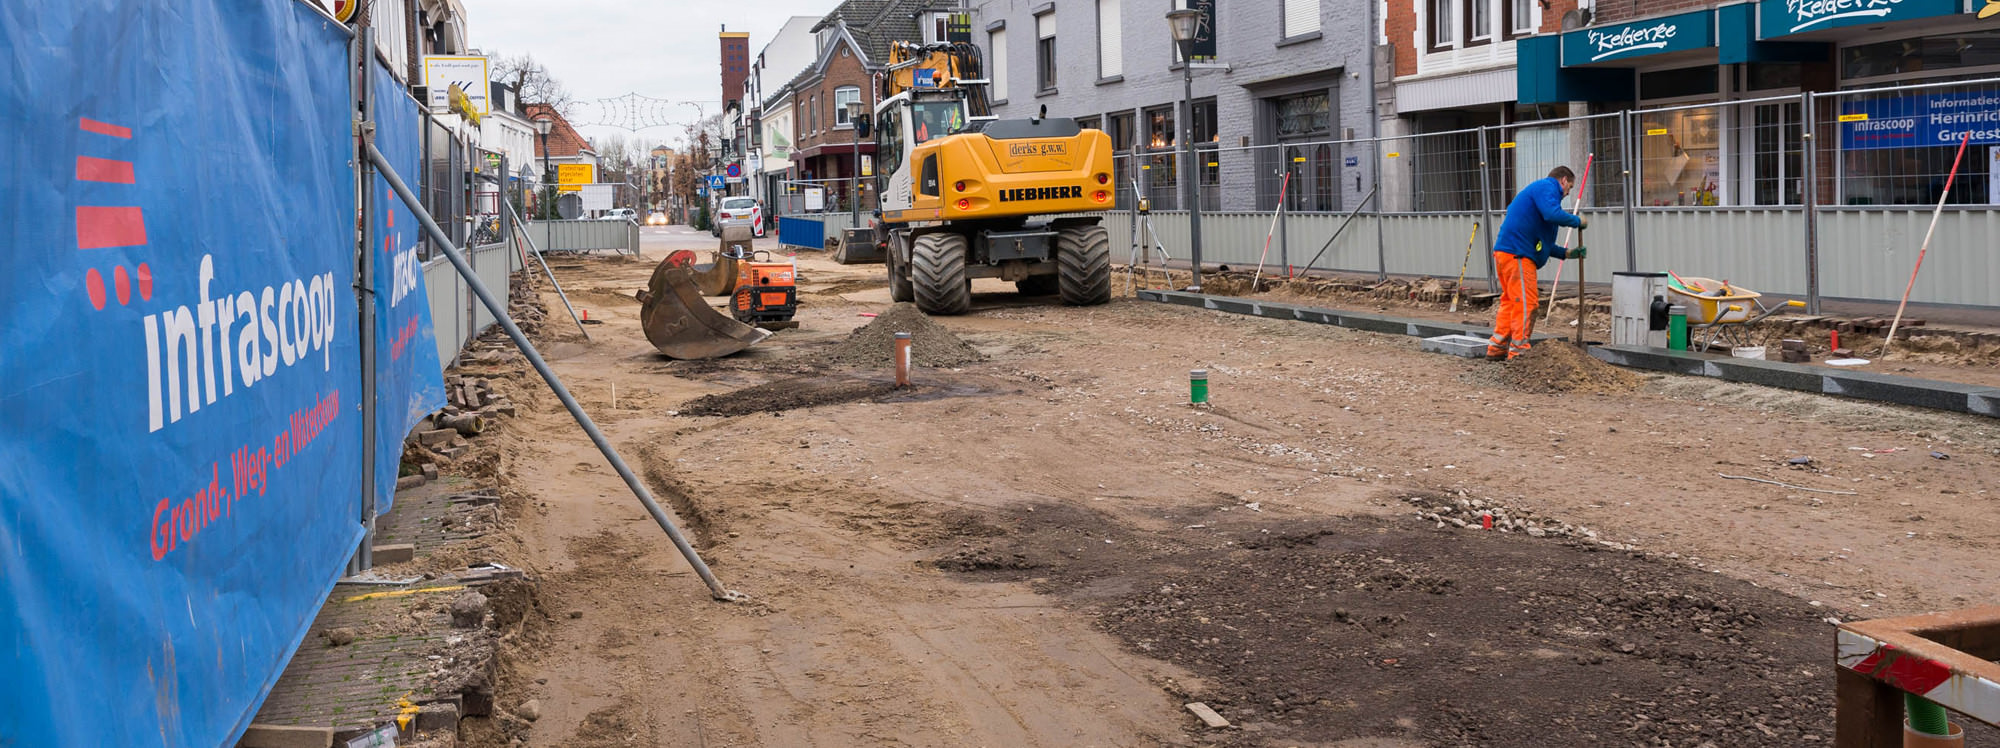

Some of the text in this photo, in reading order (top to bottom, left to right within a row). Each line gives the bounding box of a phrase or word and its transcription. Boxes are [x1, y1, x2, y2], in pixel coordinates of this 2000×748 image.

[1598, 23, 1676, 52] Kelderke
[1854, 118, 1914, 132] infrascoop
[1930, 110, 2000, 125] Herinric
[1011, 144, 1064, 156] derks g.w.w.
[999, 185, 1083, 203] LIEBHERR
[143, 253, 335, 433] infrascoop
[150, 388, 340, 561] Grond-, Weg- en Waterbouw
